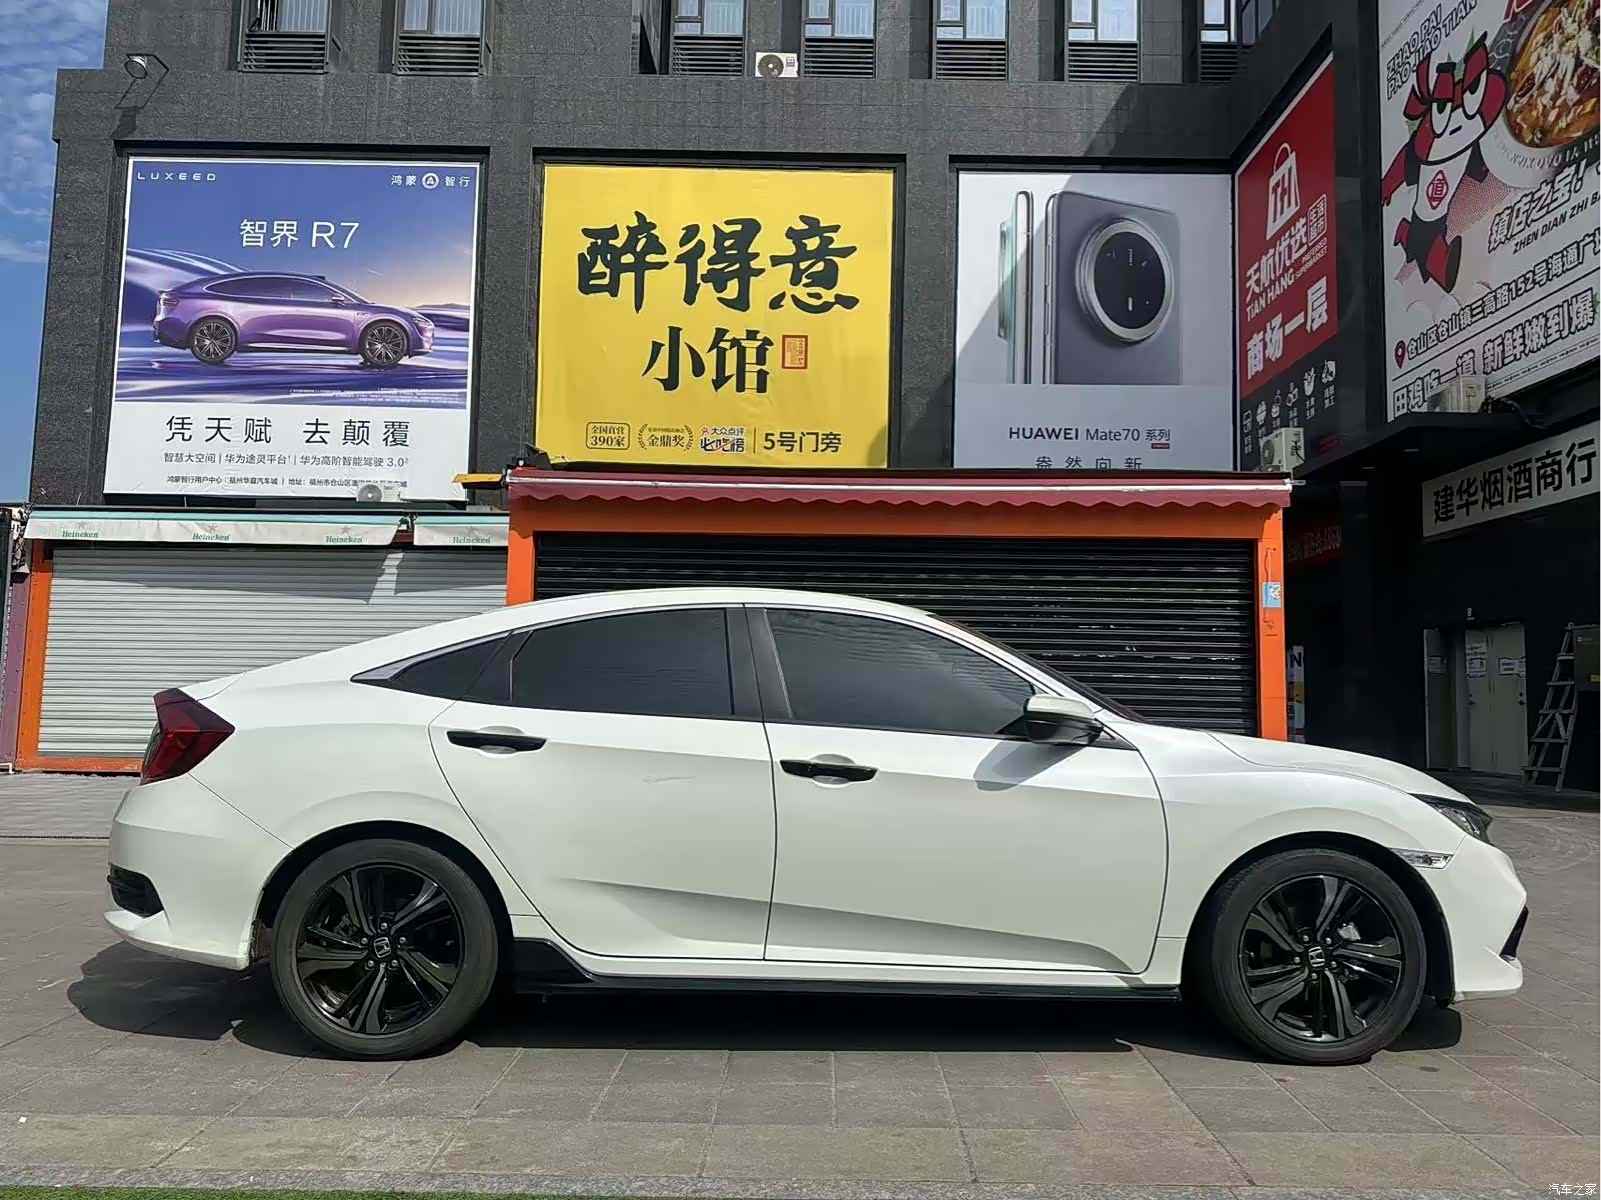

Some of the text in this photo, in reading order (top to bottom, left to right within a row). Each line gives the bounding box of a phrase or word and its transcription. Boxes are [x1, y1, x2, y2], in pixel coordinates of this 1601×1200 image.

[1387, 32, 1418, 81] ZHAO
[1420, 3, 1442, 43] PAI
[1387, 61, 1411, 100] PAO
[1412, 26, 1442, 72] JIAO
[137, 172, 217, 181] LUXEED
[390, 174, 471, 188] 鸿蒙 智行
[240, 218, 360, 249] 智界 R7
[1512, 229, 1539, 255] ZHEN
[1540, 210, 1567, 237] DIAN
[1569, 197, 1588, 219] ZHI
[577, 210, 860, 314] 醉得意
[1245, 216, 1308, 303] 天航优选
[1266, 267, 1295, 302] HANG
[1246, 276, 1329, 380] 商场一层
[1482, 286, 1596, 376] 新鲜嫩到爆
[641, 326, 774, 394] 小馆
[165, 416, 411, 447] 凭天赋 去颠覆
[591, 425, 625, 436] 全国直营
[710, 427, 745, 436] 大众点评
[1008, 427, 1171, 442] HUAWEI Mate70 系列
[590, 435, 626, 447] 390家
[646, 434, 685, 448] 金鼎奖
[699, 437, 745, 453] 必吃榜
[763, 431, 842, 453] 5号门旁
[164, 453, 216, 464] 智慧大空间
[299, 455, 384, 468] 华为高阶智能驾驶
[1432, 437, 1598, 526] 建华烟酒商行
[61, 529, 99, 539] Heineken
[192, 531, 230, 542] Heineken
[325, 534, 363, 544] Heineken
[452, 535, 491, 545] Heineken
